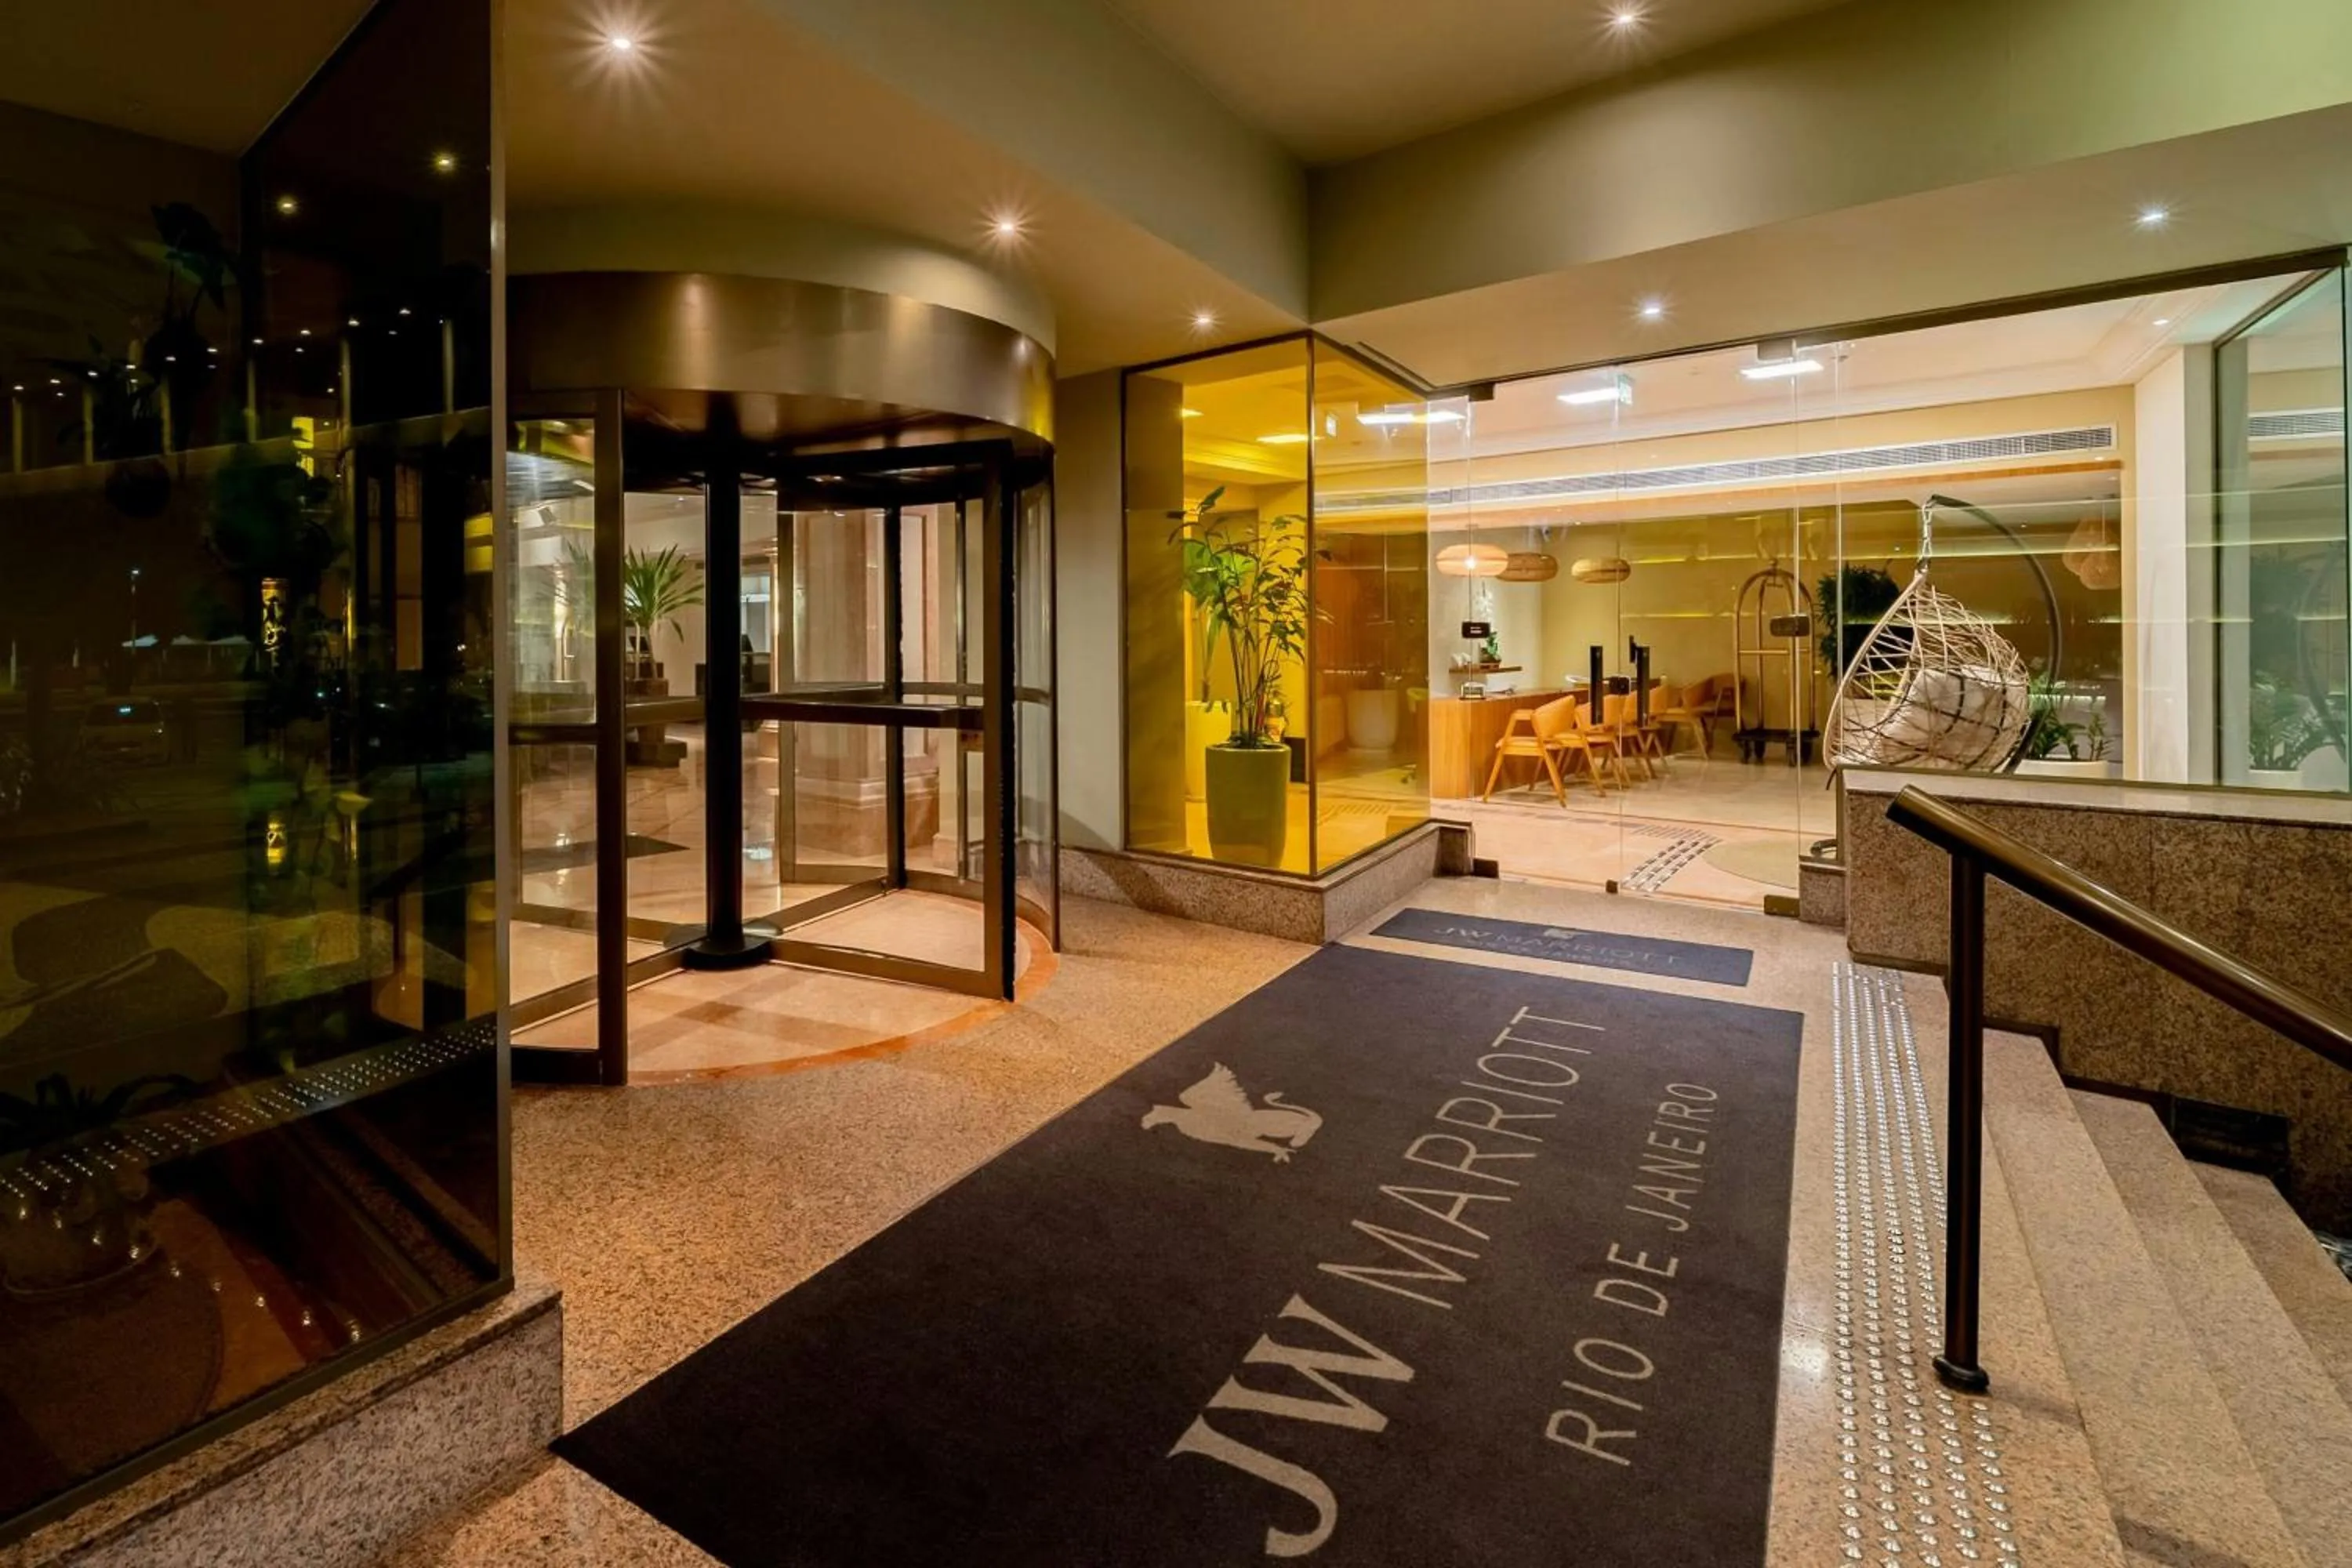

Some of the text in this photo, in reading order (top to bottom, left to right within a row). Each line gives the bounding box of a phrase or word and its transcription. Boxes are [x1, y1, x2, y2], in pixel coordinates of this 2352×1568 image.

[1166, 1293, 1414, 1557] JW
[1316, 1006, 1606, 1310] MARRIOTT
[1544, 1083, 1719, 1466] RIO DE JANEIRO
